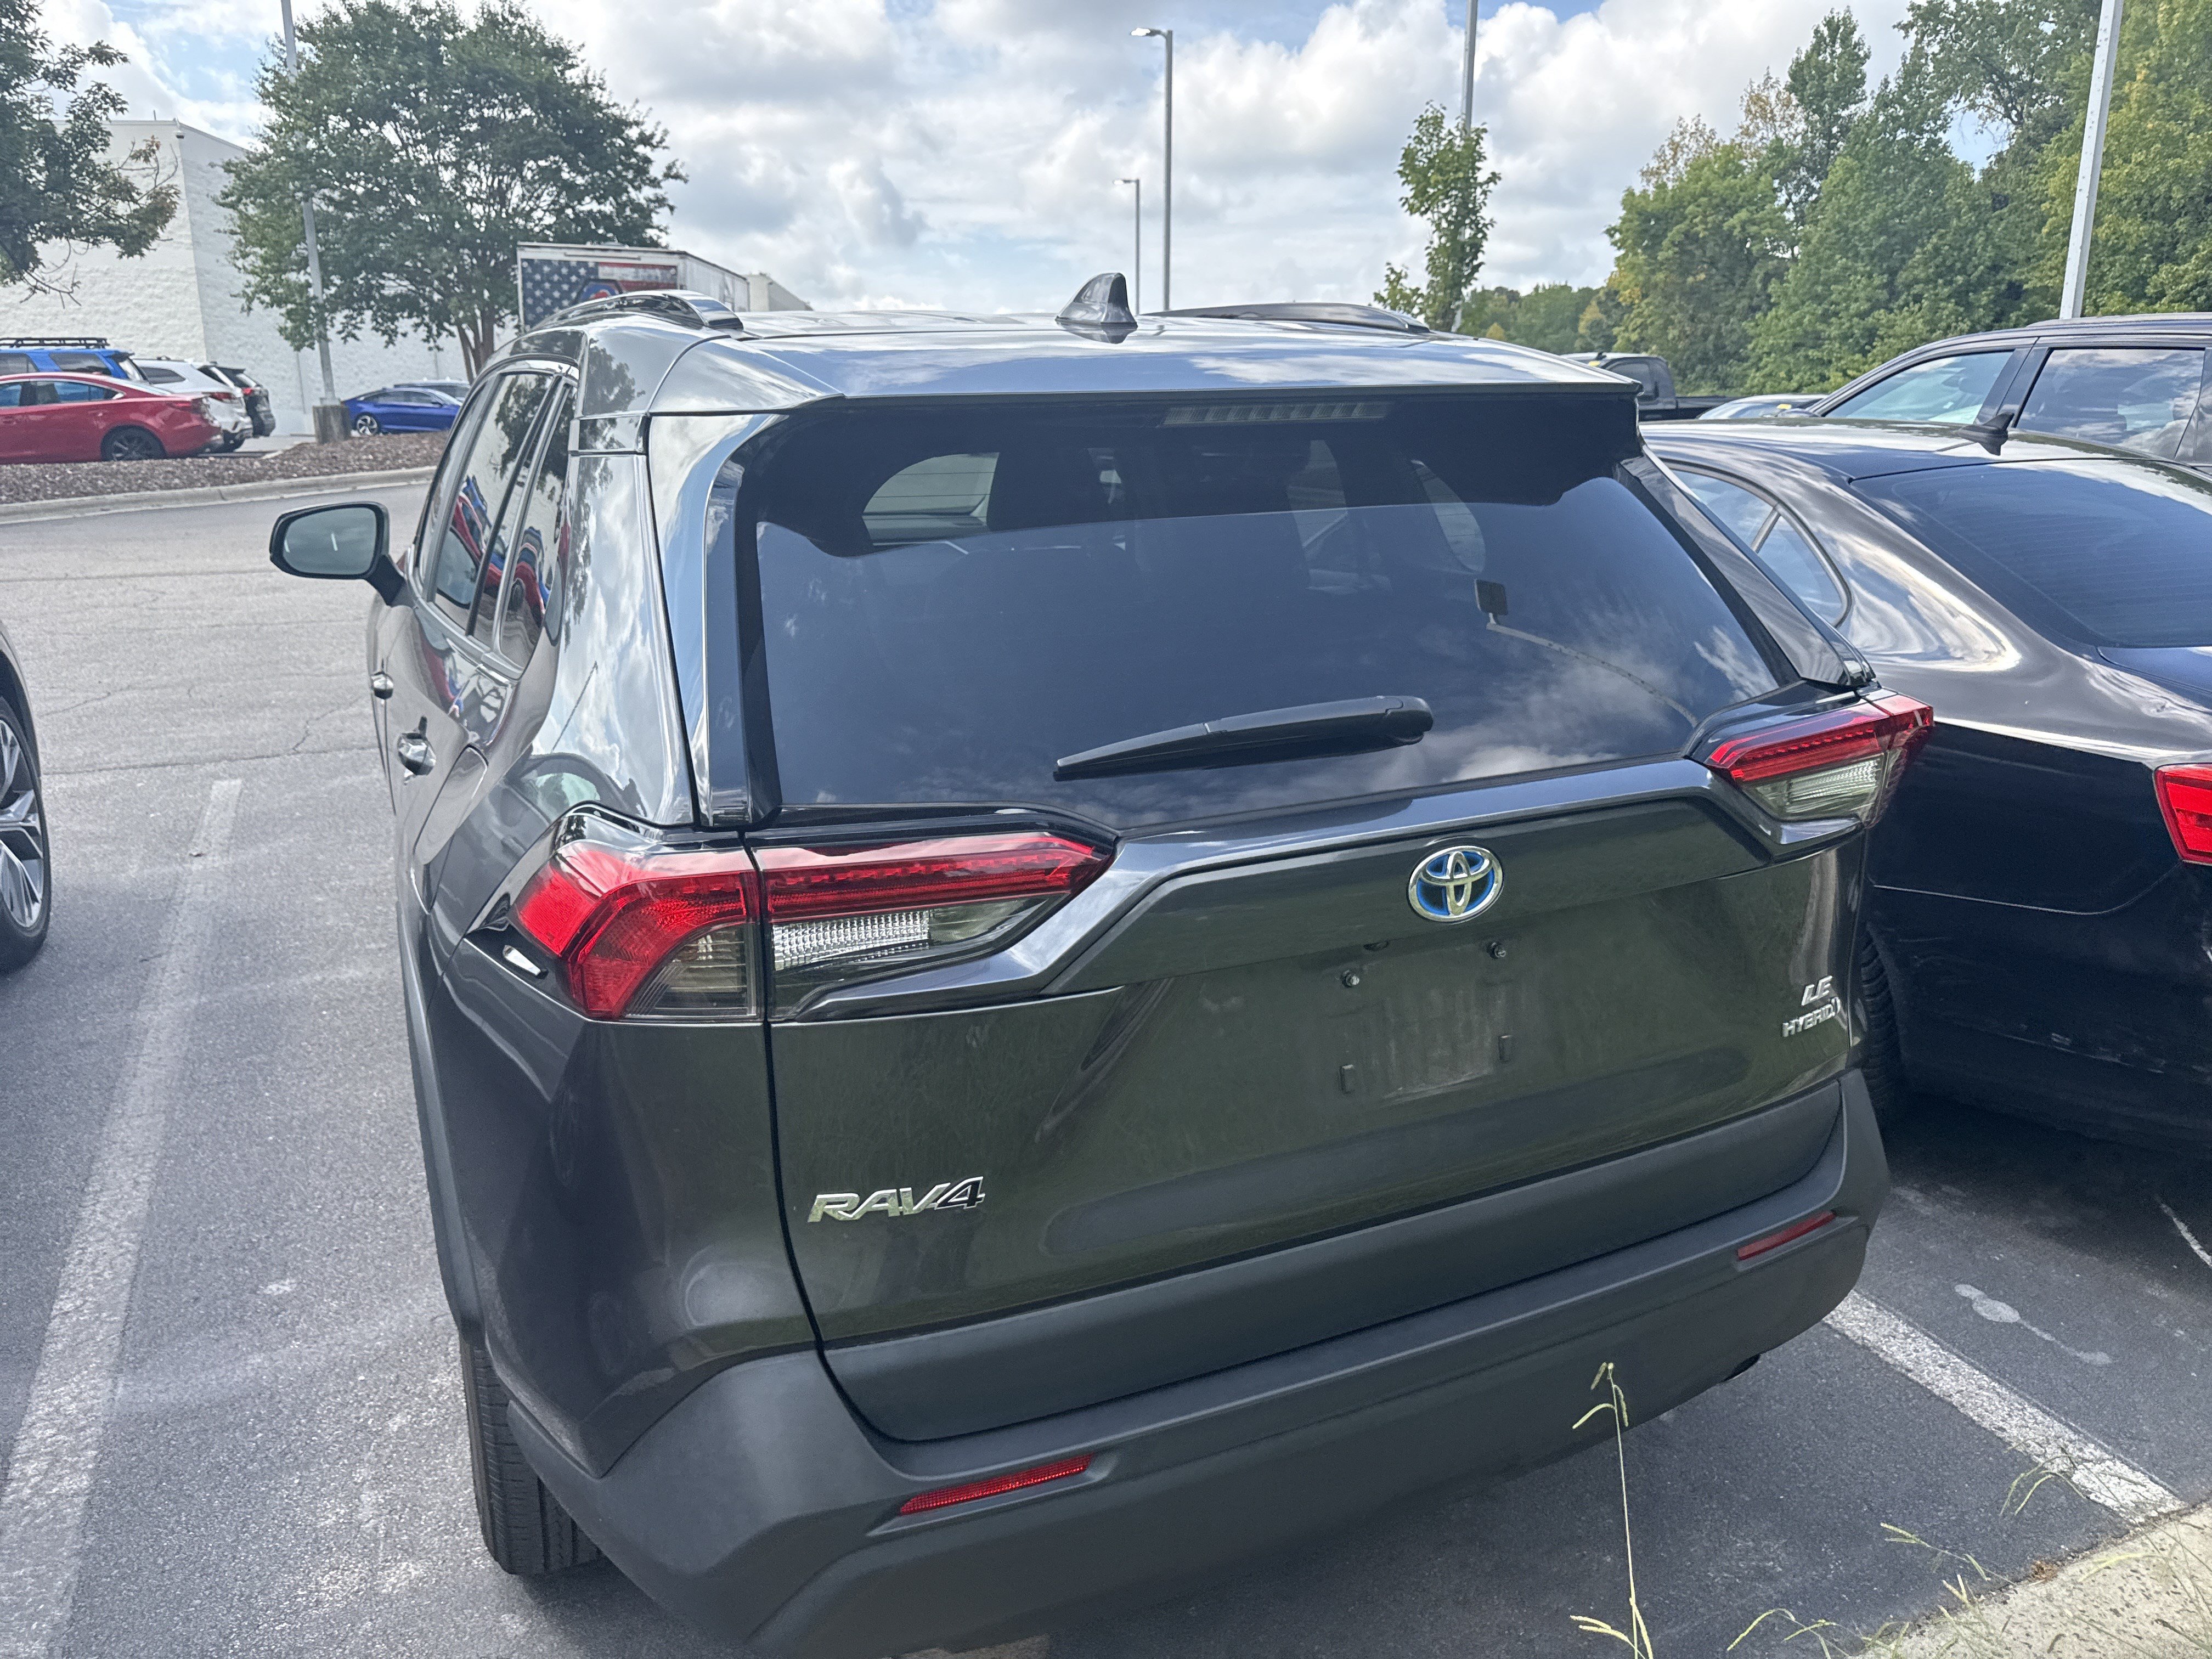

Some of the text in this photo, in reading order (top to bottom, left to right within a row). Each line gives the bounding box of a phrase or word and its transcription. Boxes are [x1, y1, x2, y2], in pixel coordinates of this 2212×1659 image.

[1801, 975, 1833, 1006] LE
[1782, 1000, 1839, 1037] HYBRID
[808, 1176, 985, 1223] RAV4
